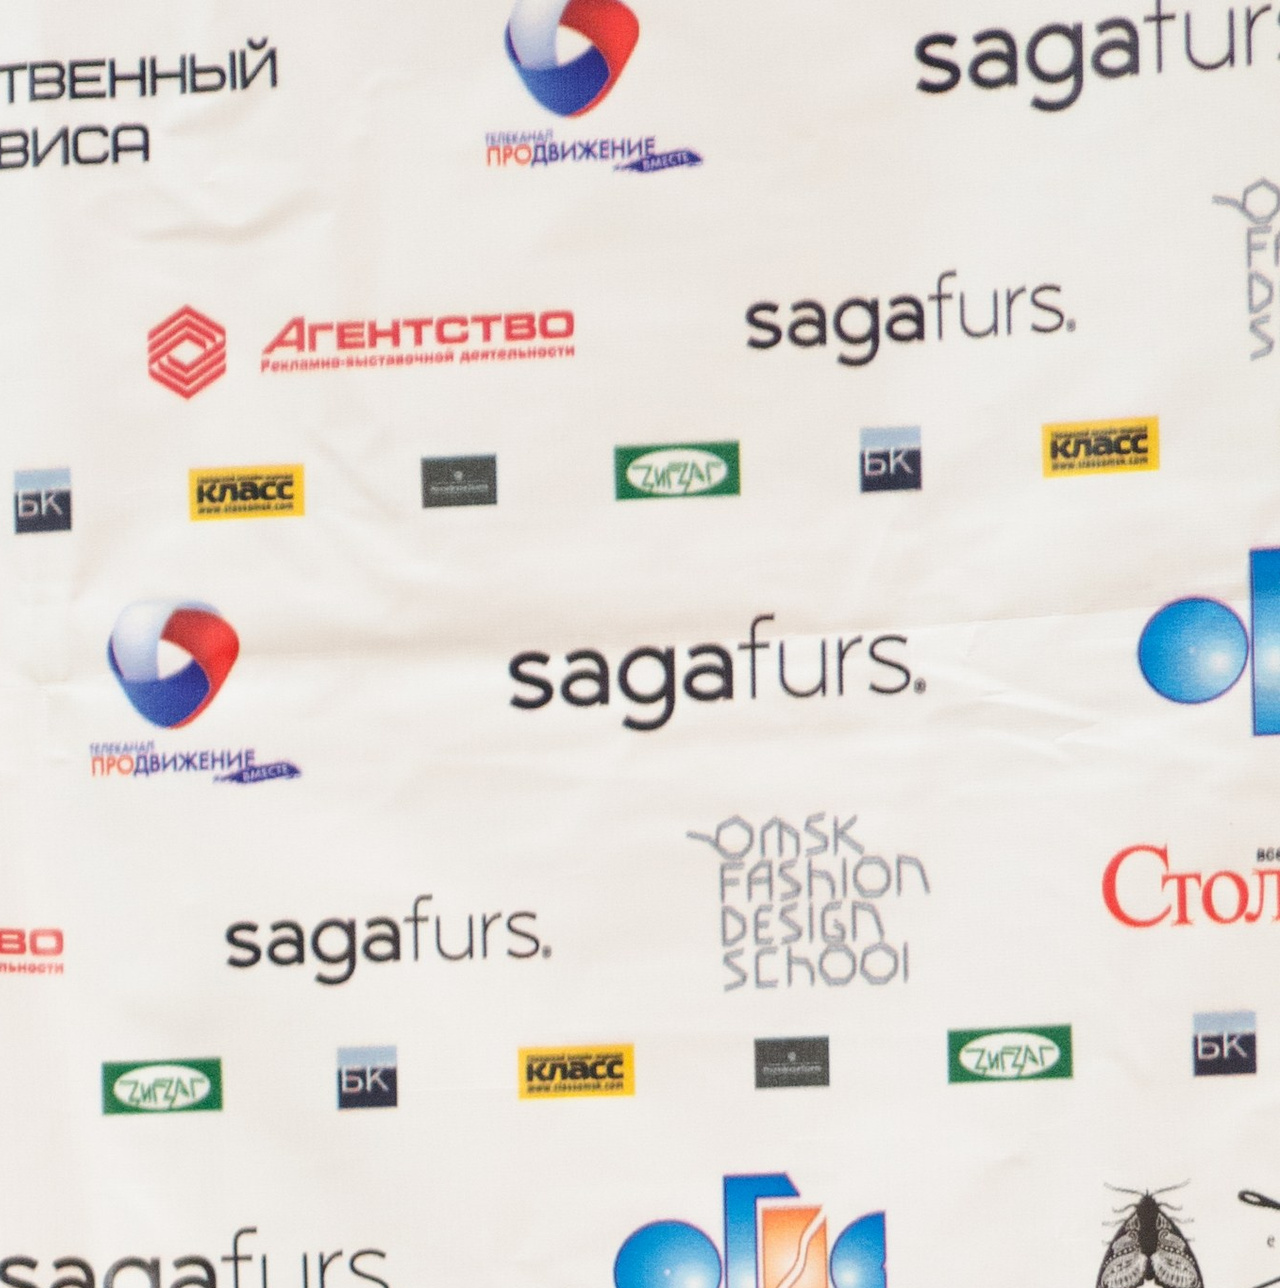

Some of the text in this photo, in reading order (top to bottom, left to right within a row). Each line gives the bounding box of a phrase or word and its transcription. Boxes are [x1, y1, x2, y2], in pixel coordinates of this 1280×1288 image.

[484, 128, 553, 145] ТЕЛЕКАНАЛ
[485, 135, 656, 169] ПРОДВИЖЕНИЕ
[863, 450, 912, 477] БК
[17, 492, 63, 519] БК
[89, 740, 155, 754] ТЕЛЕКАНАЛ
[90, 747, 255, 778] ПРОДВИЖЕНИЕ
[1196, 1035, 1247, 1062] БК
[340, 1069, 388, 1095] БК
